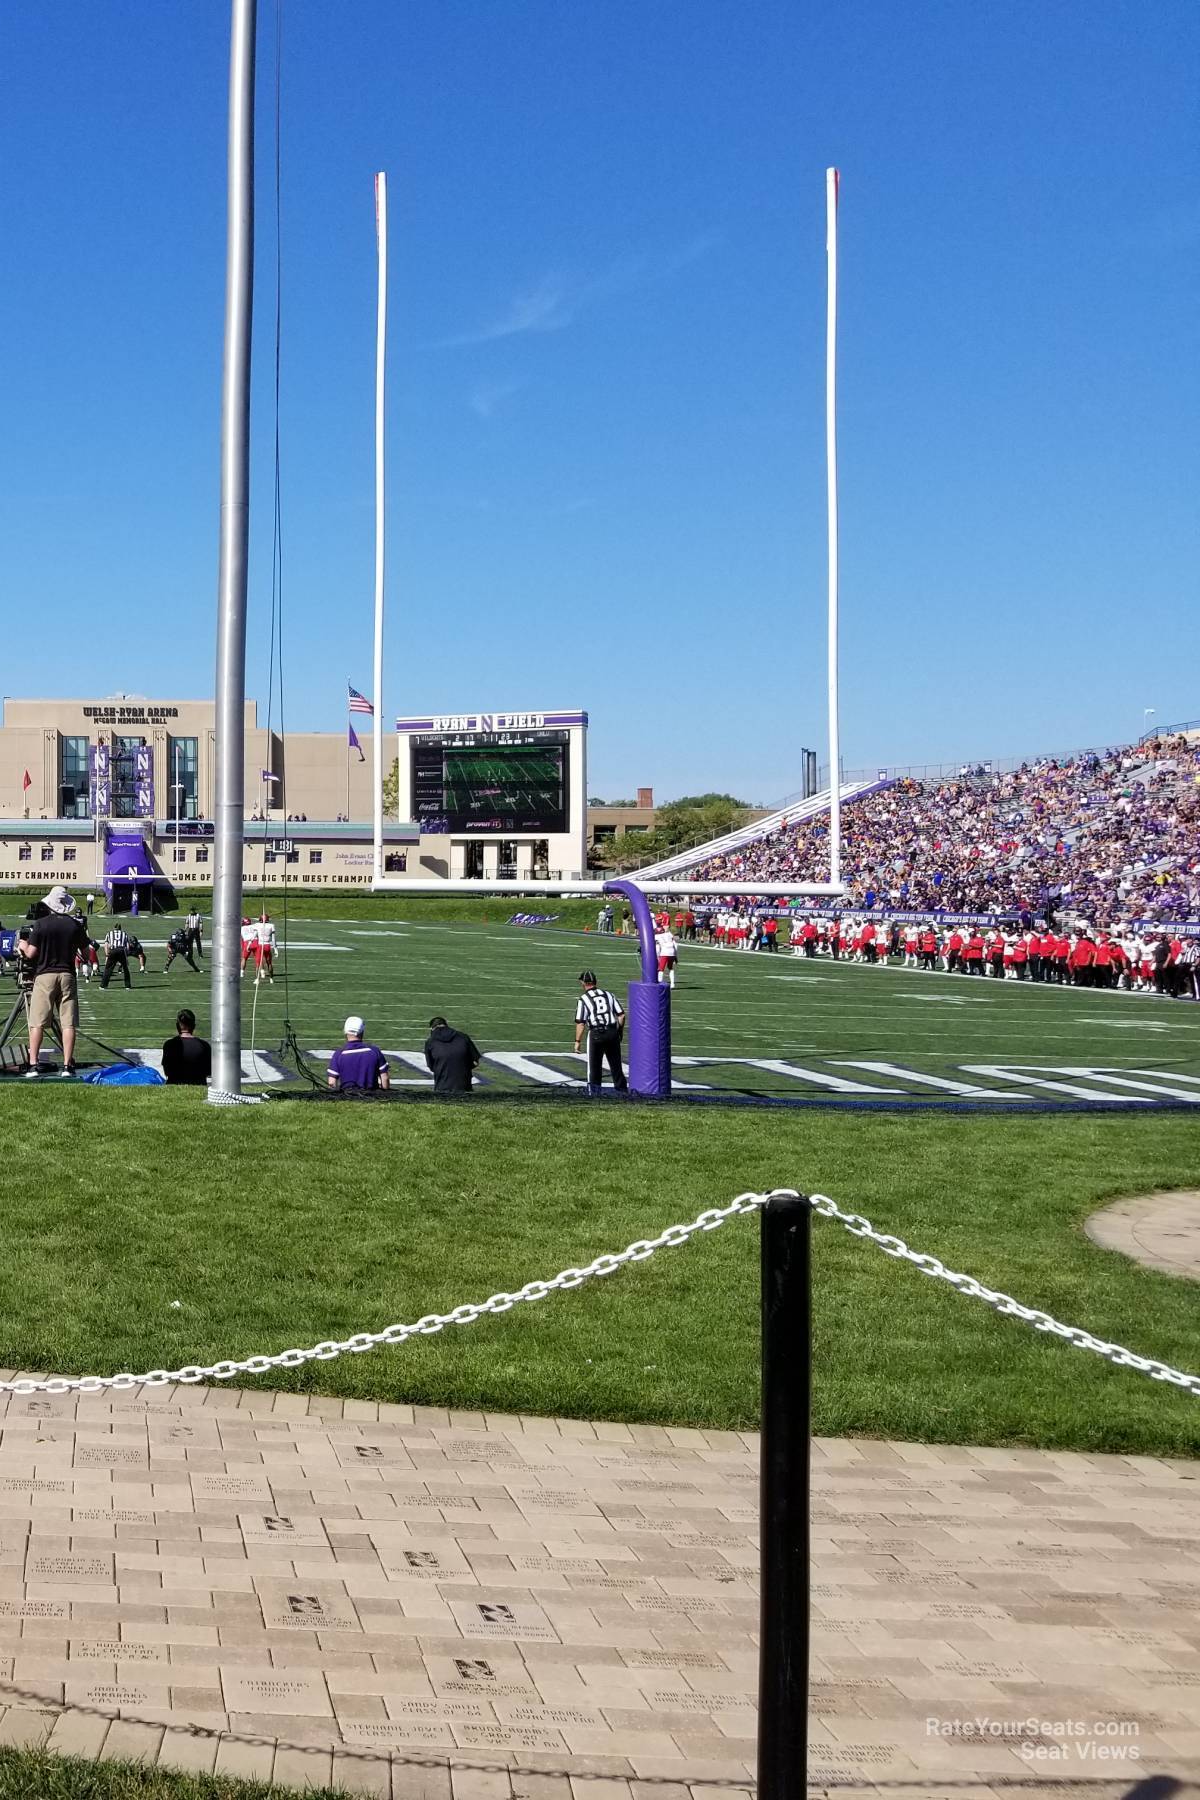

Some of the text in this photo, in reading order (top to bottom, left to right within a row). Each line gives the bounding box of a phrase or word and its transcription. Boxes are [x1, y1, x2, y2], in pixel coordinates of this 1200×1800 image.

[83, 707, 179, 717] WELSH-RYAN ARENA
[117, 717, 150, 725] MEMORIAL
[151, 717, 168, 725] HALL
[432, 714, 545, 732] RYAN N FIELD
[138, 754, 149, 770] N
[139, 790, 151, 806] N
[25, 872, 78, 880] CHAMPIONS
[242, 874, 258, 882] 018
[261, 874, 277, 882] BIG
[302, 875, 329, 883] WEST
[331, 875, 374, 883] CHAMPIO
[592, 996, 608, 1014] B
[345, 1723, 403, 1731] STEPHANIE
[463, 1725, 549, 1735] BRUNO ADAMS
